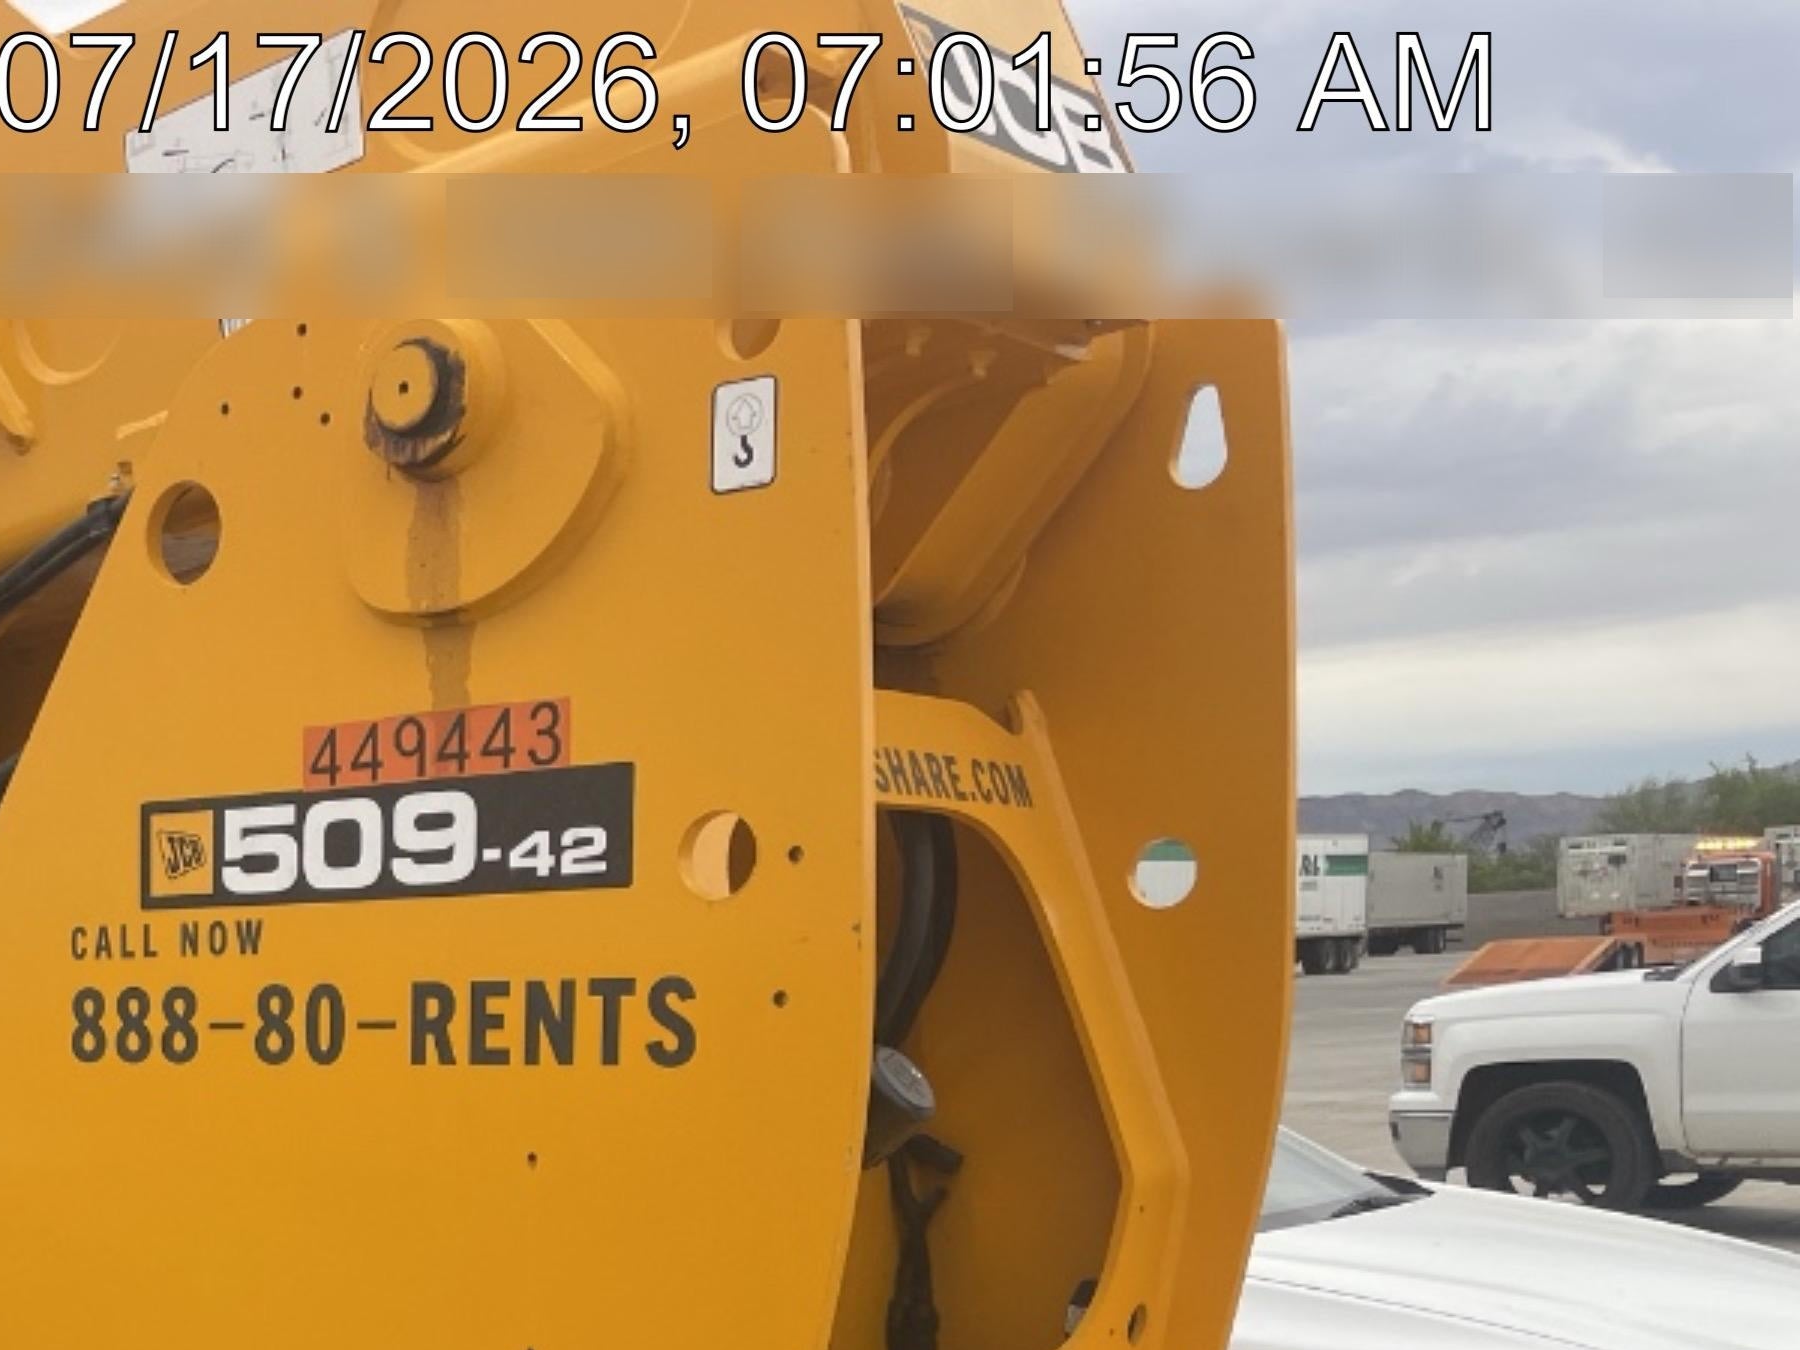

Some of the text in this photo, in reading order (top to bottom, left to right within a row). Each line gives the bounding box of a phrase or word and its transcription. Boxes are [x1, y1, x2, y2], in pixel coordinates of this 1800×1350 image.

[310, 701, 562, 786] 449443
[875, 747, 1033, 808] SHARE.COM
[221, 790, 607, 894] 509-42
[71, 918, 264, 961] CALL NOW
[70, 974, 699, 1068] 888-80-RENTS
